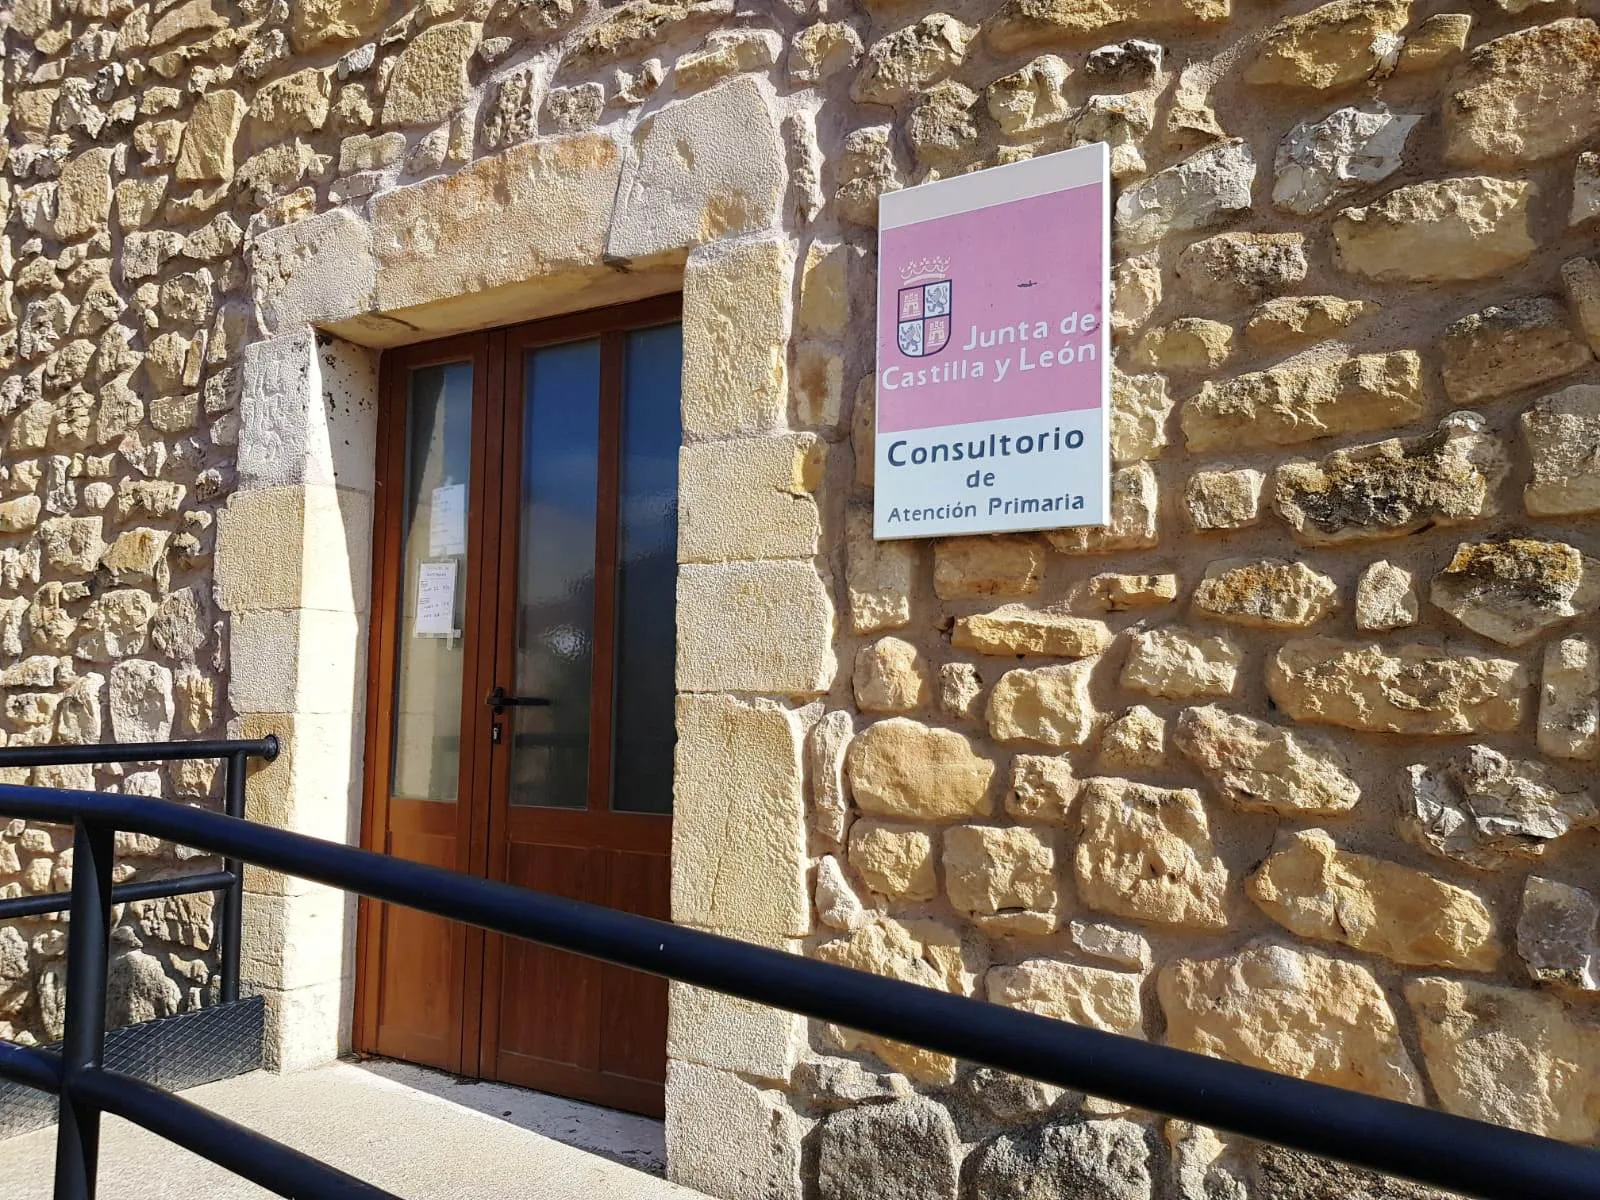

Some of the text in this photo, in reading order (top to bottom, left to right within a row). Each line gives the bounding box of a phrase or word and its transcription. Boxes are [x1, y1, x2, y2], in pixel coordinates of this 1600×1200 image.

[962, 311, 1096, 351] Junta de
[881, 340, 1096, 390] Castilla y León
[887, 427, 1084, 467] Consultorio
[966, 470, 995, 488] de
[887, 493, 1084, 523] Atención Primaria
